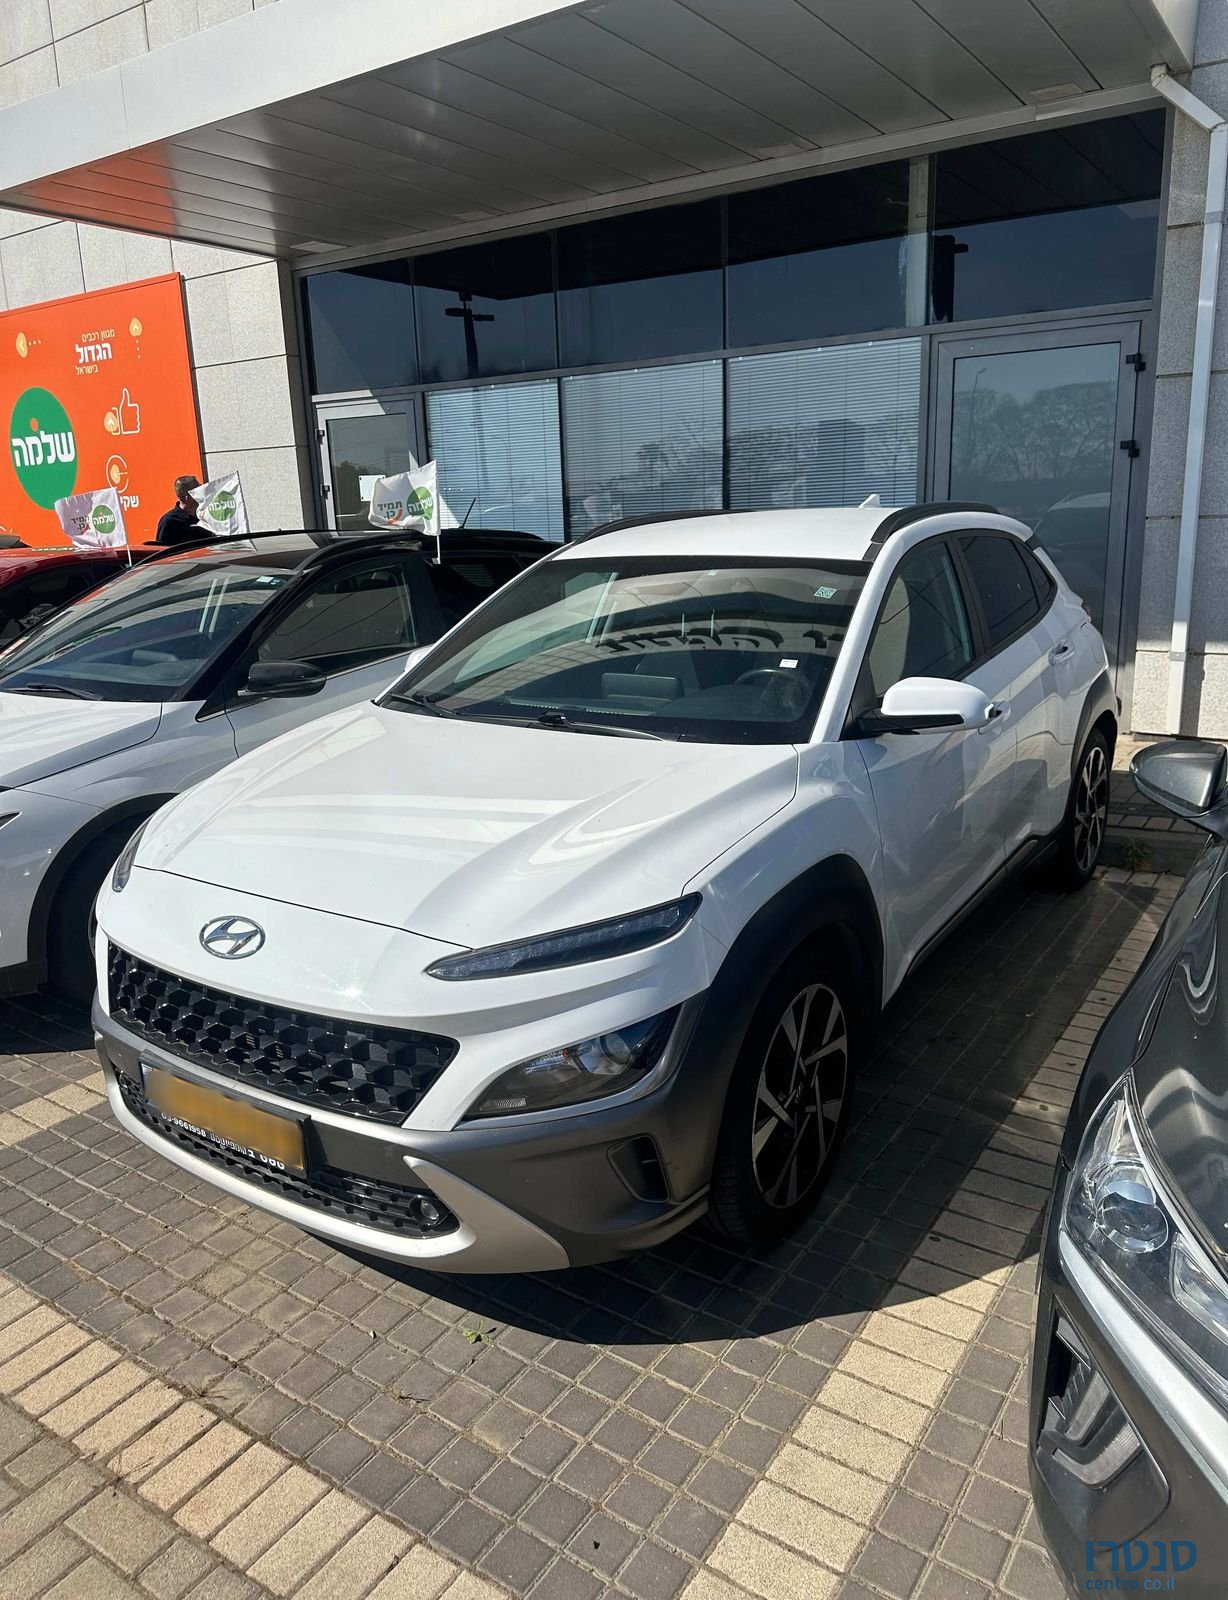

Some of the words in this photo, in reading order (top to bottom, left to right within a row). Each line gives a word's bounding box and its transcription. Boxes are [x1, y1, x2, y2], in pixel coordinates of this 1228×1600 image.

[75, 342, 113, 364] הגדול
[75, 364, 99, 376] בישראל
[11, 430, 76, 467] שלמה
[120, 495, 140, 512] שקי
[208, 499, 236, 512] שלמה
[377, 501, 403, 511] תמיד
[408, 497, 433, 513] שלמה
[92, 514, 114, 526] שלמה
